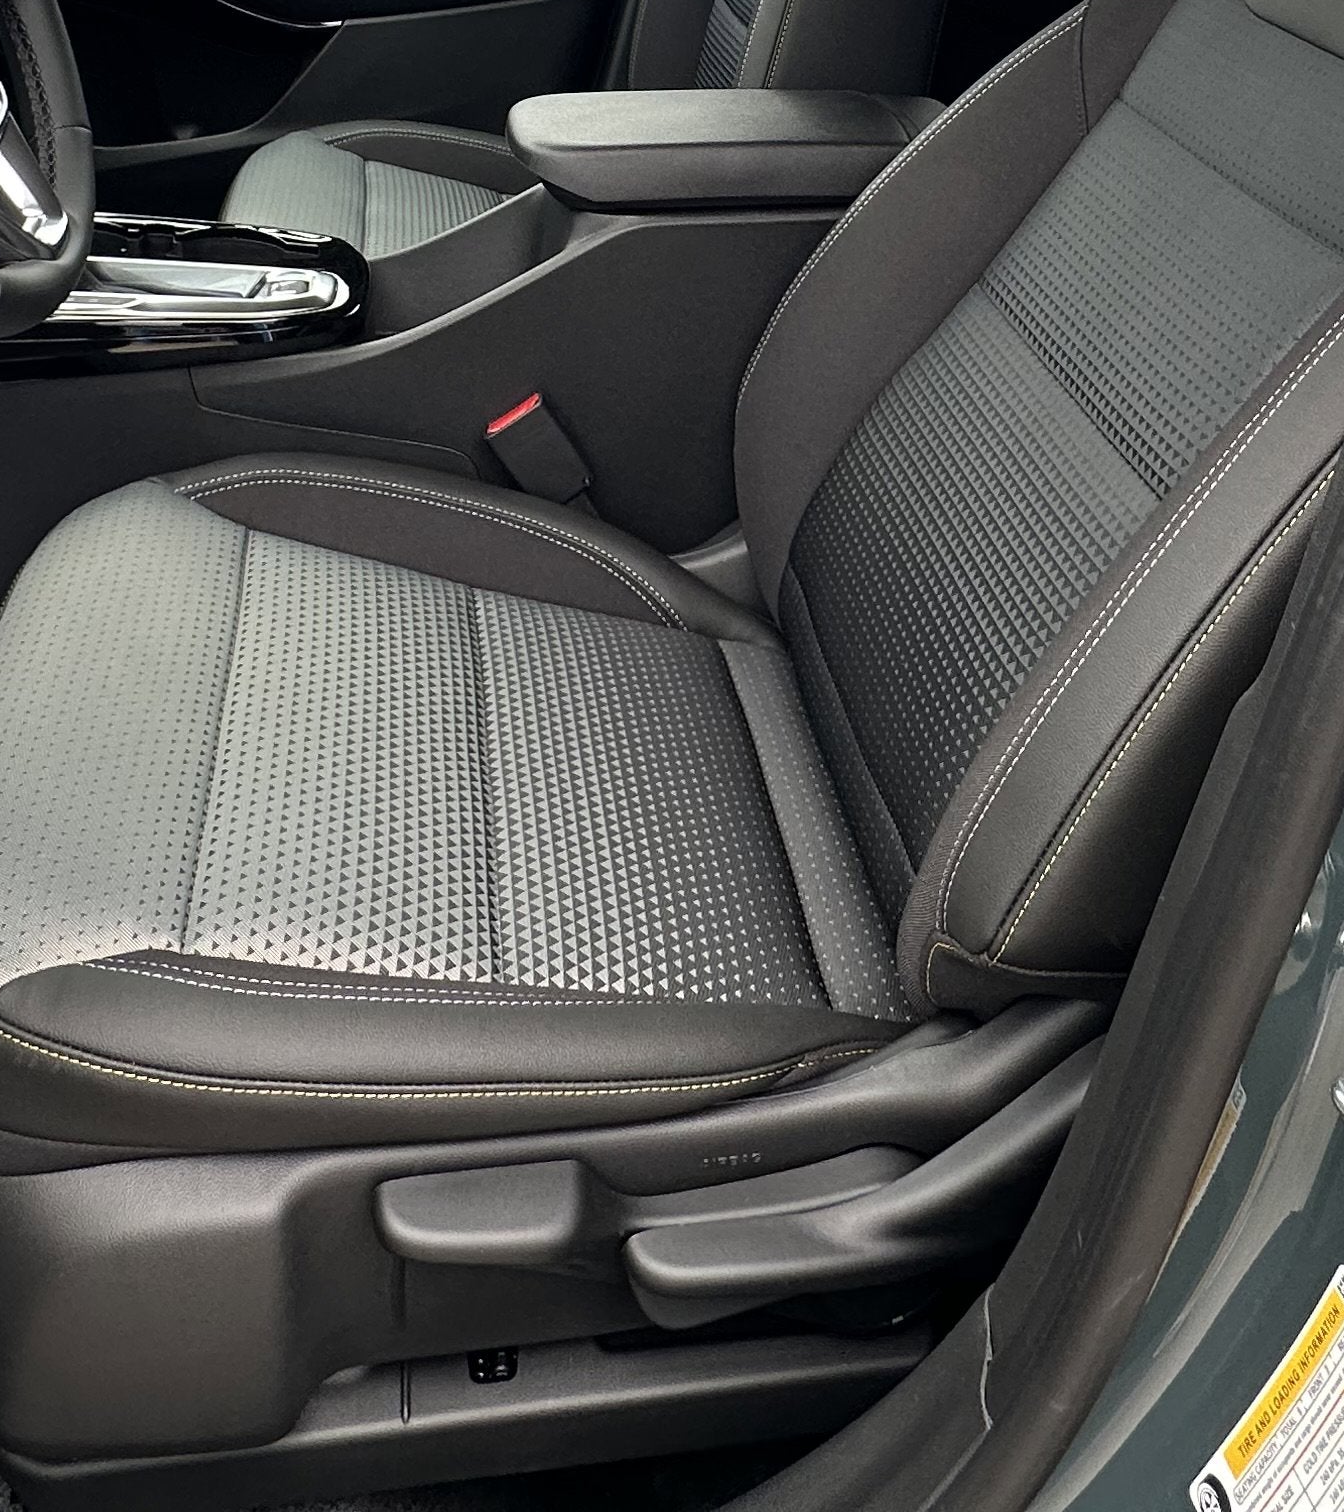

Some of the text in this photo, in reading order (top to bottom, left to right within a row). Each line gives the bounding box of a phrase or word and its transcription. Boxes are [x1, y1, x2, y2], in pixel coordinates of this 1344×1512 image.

[1237, 1304, 1341, 1459] TIRE AND LOADING INFORMATION
